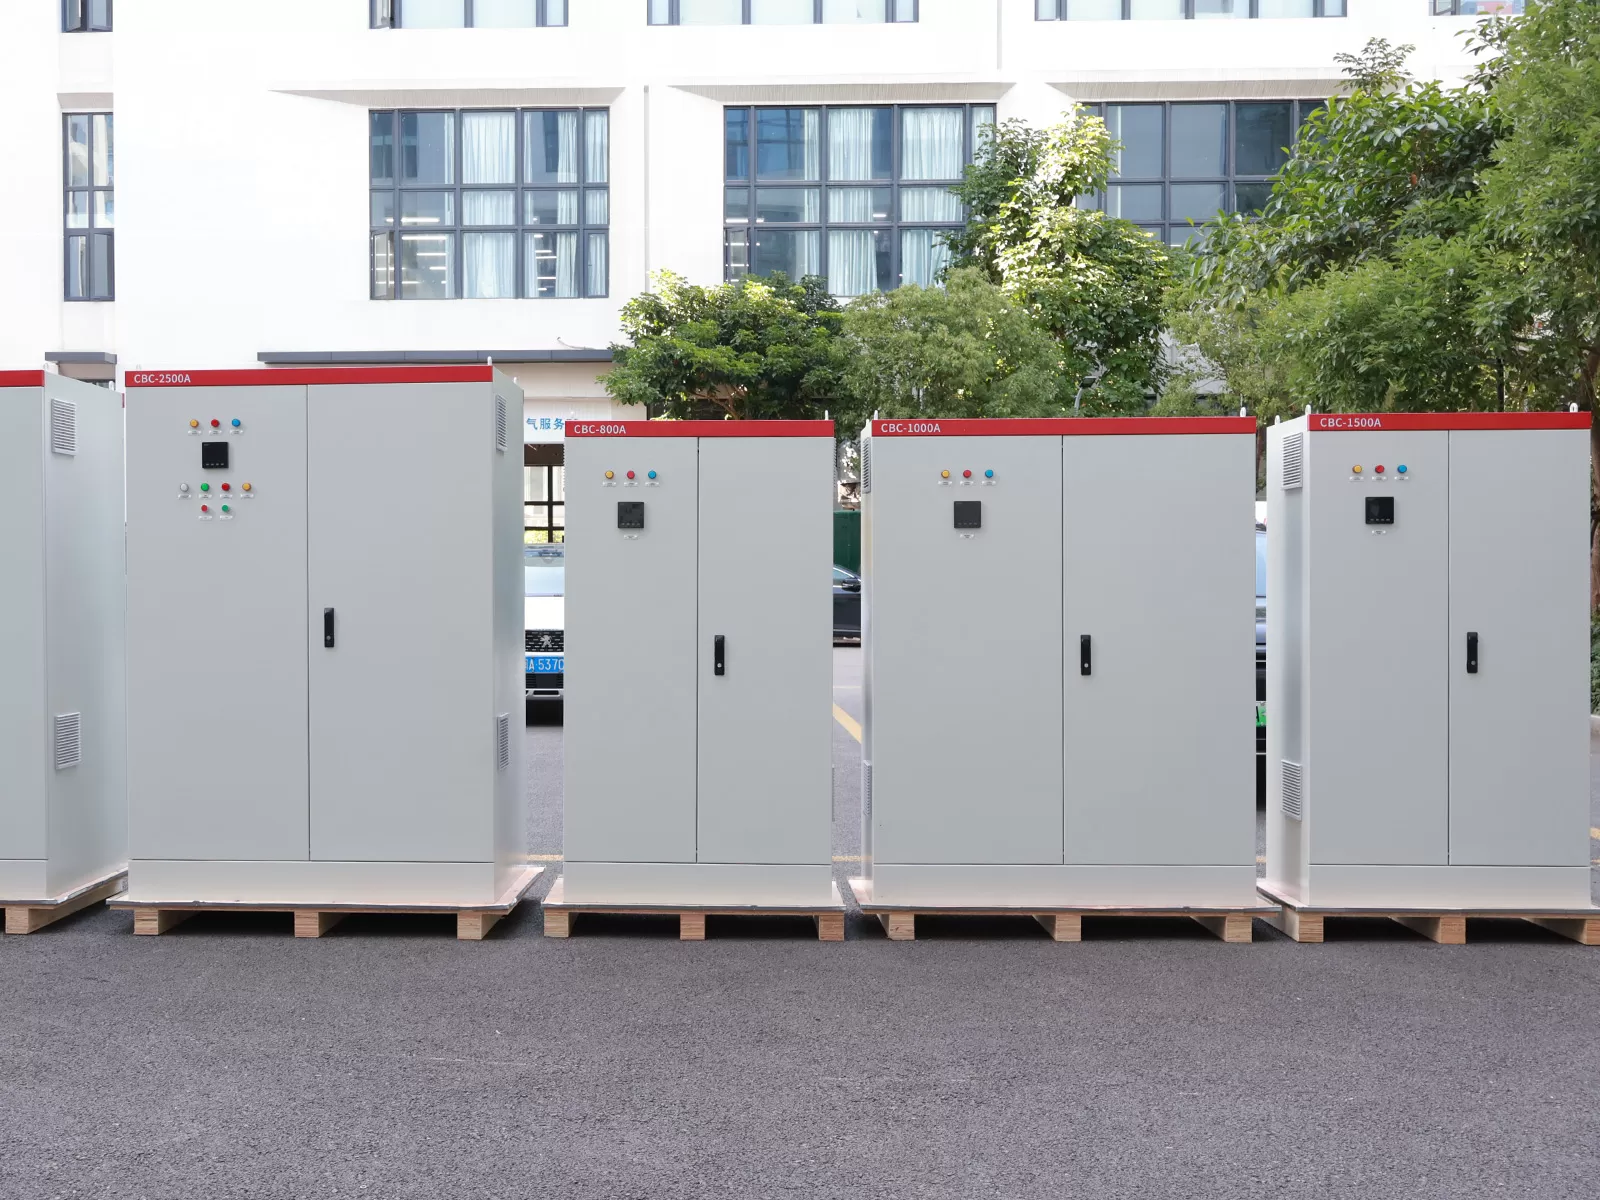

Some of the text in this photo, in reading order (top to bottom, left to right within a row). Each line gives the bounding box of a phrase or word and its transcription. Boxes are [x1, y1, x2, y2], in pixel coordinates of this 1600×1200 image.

[133, 374, 191, 384] CBC-2500A
[526, 417, 579, 431] 气服务
[1319, 417, 1382, 428] CBC-1500A
[573, 424, 627, 434] CBC-800A
[880, 423, 941, 433] CBC-1000A
